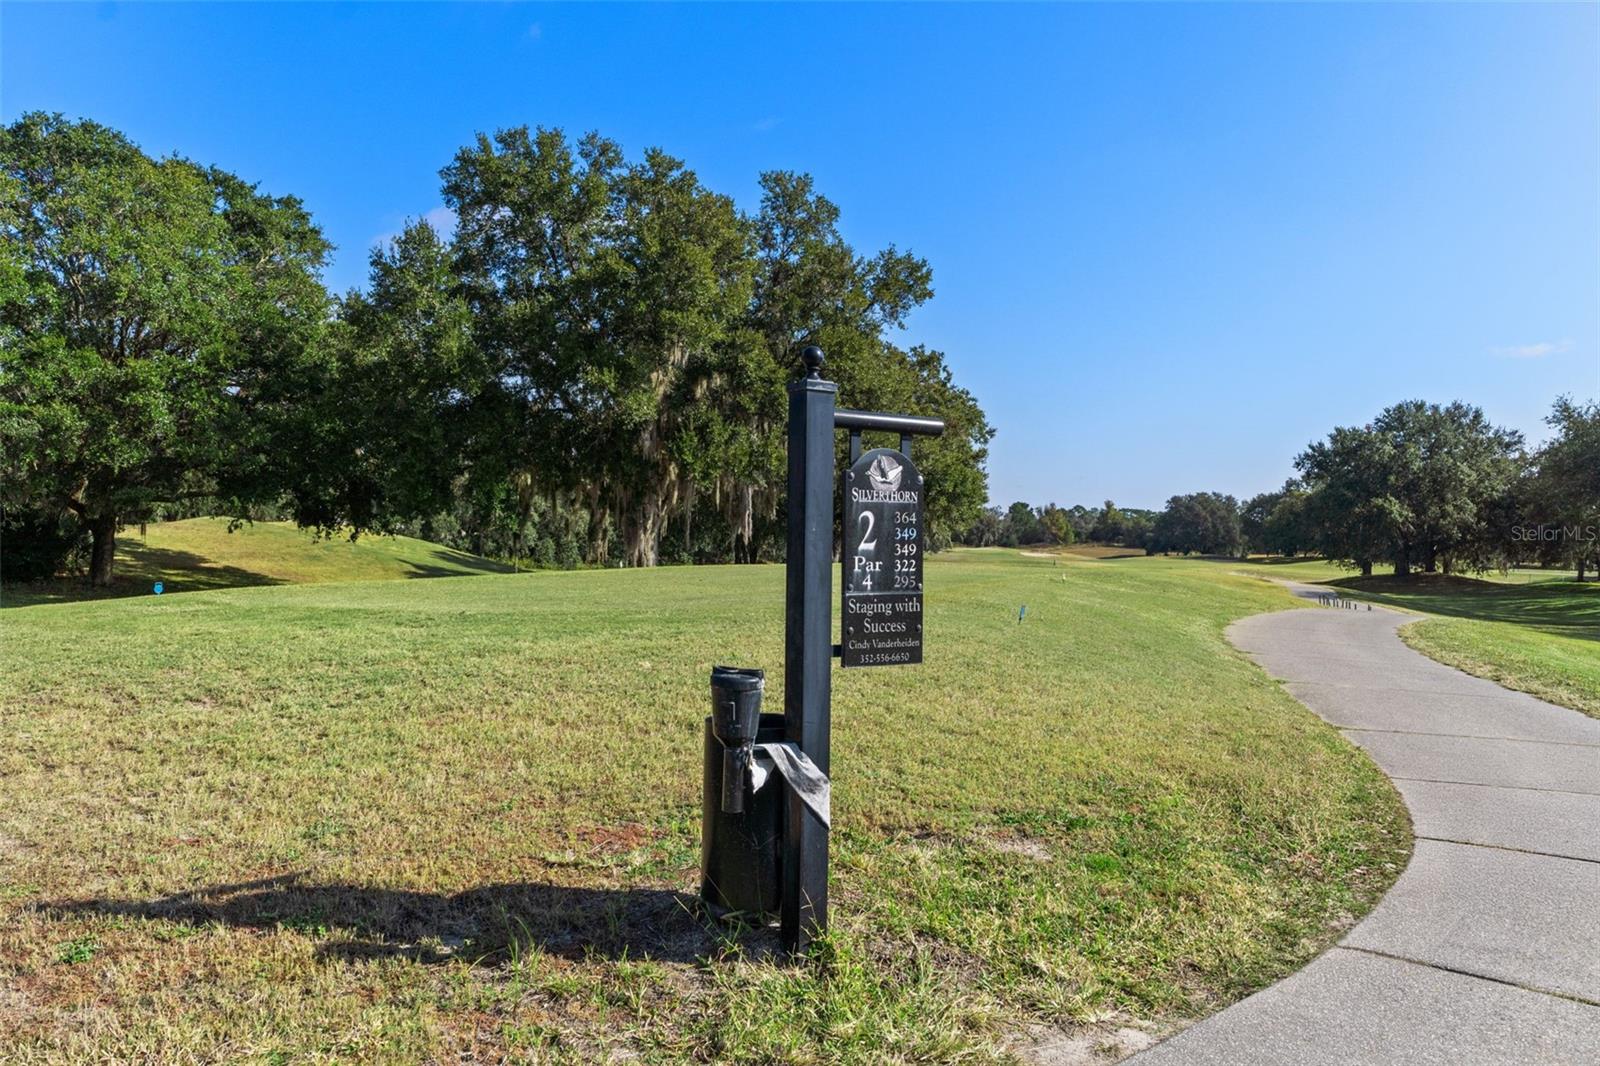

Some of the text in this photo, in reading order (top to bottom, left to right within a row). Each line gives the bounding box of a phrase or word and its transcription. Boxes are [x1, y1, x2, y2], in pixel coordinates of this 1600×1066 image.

[852, 487, 918, 503] SILVERTHORN
[895, 511, 917, 524] 364
[858, 510, 877, 551] 2
[895, 527, 917, 540] 349
[894, 543, 917, 556] 349
[853, 555, 884, 572] Par
[894, 560, 917, 572] 322
[862, 574, 873, 590] 4
[894, 575, 916, 588] 295
[848, 597, 921, 617] Staging with
[863, 618, 906, 634] Success
[848, 638, 920, 650] Cindy Vanderheiden
